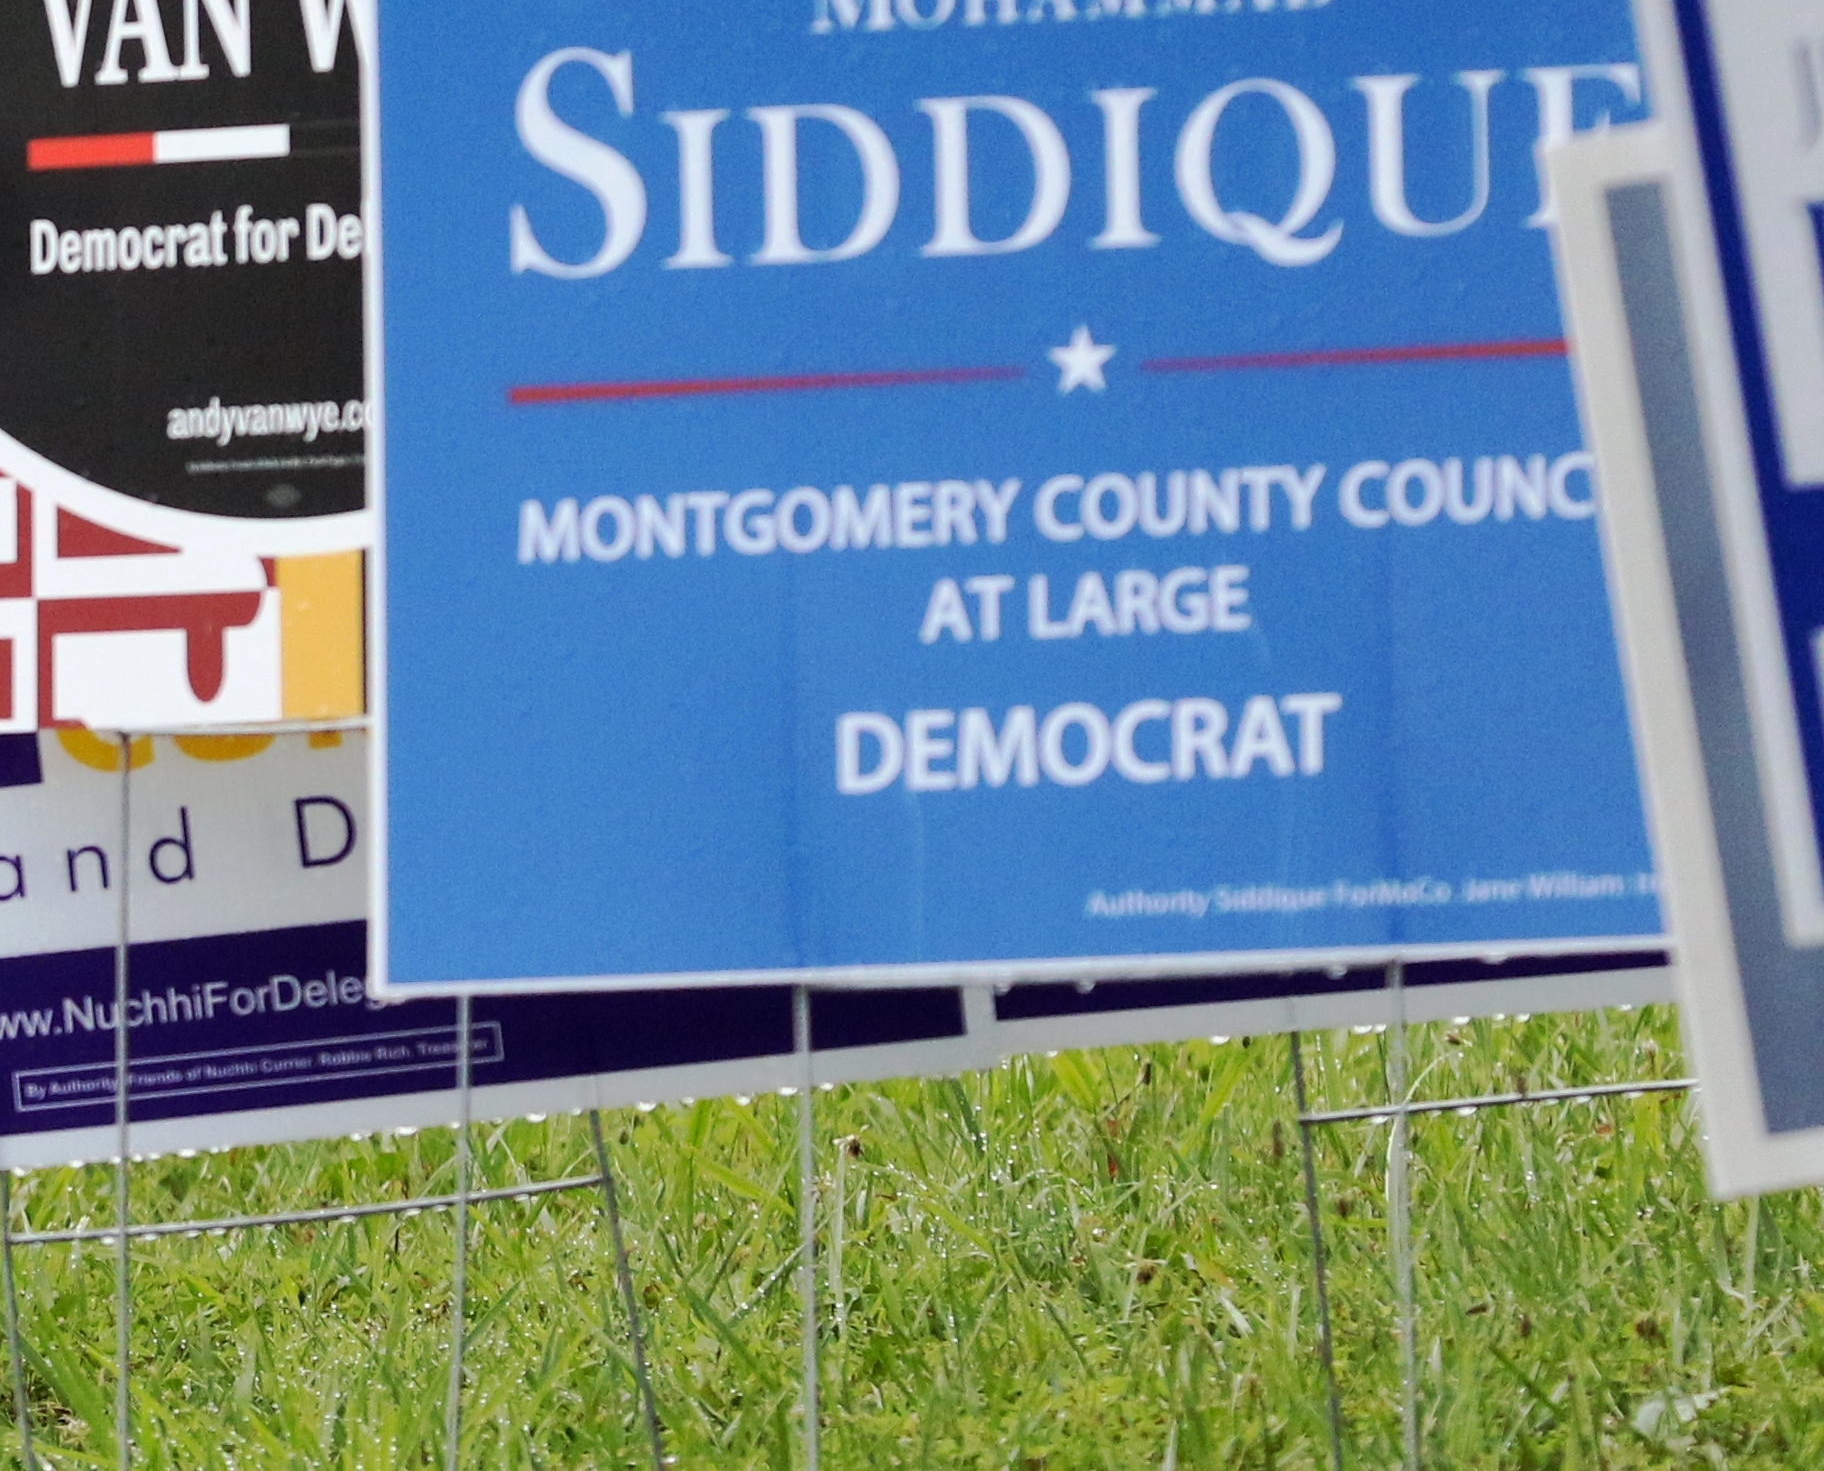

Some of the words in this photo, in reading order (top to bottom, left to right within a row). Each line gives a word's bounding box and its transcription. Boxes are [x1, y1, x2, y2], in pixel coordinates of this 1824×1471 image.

[29, 210, 229, 275] Democrat
[234, 206, 299, 263] for
[518, 477, 1022, 566] MONTGOMERY
[1033, 464, 1328, 544] COUNTY
[919, 576, 1012, 645] AT
[1027, 565, 1253, 640] LARGE
[836, 692, 1343, 796] DEMOCRAT
[1085, 890, 1212, 918] Authority
